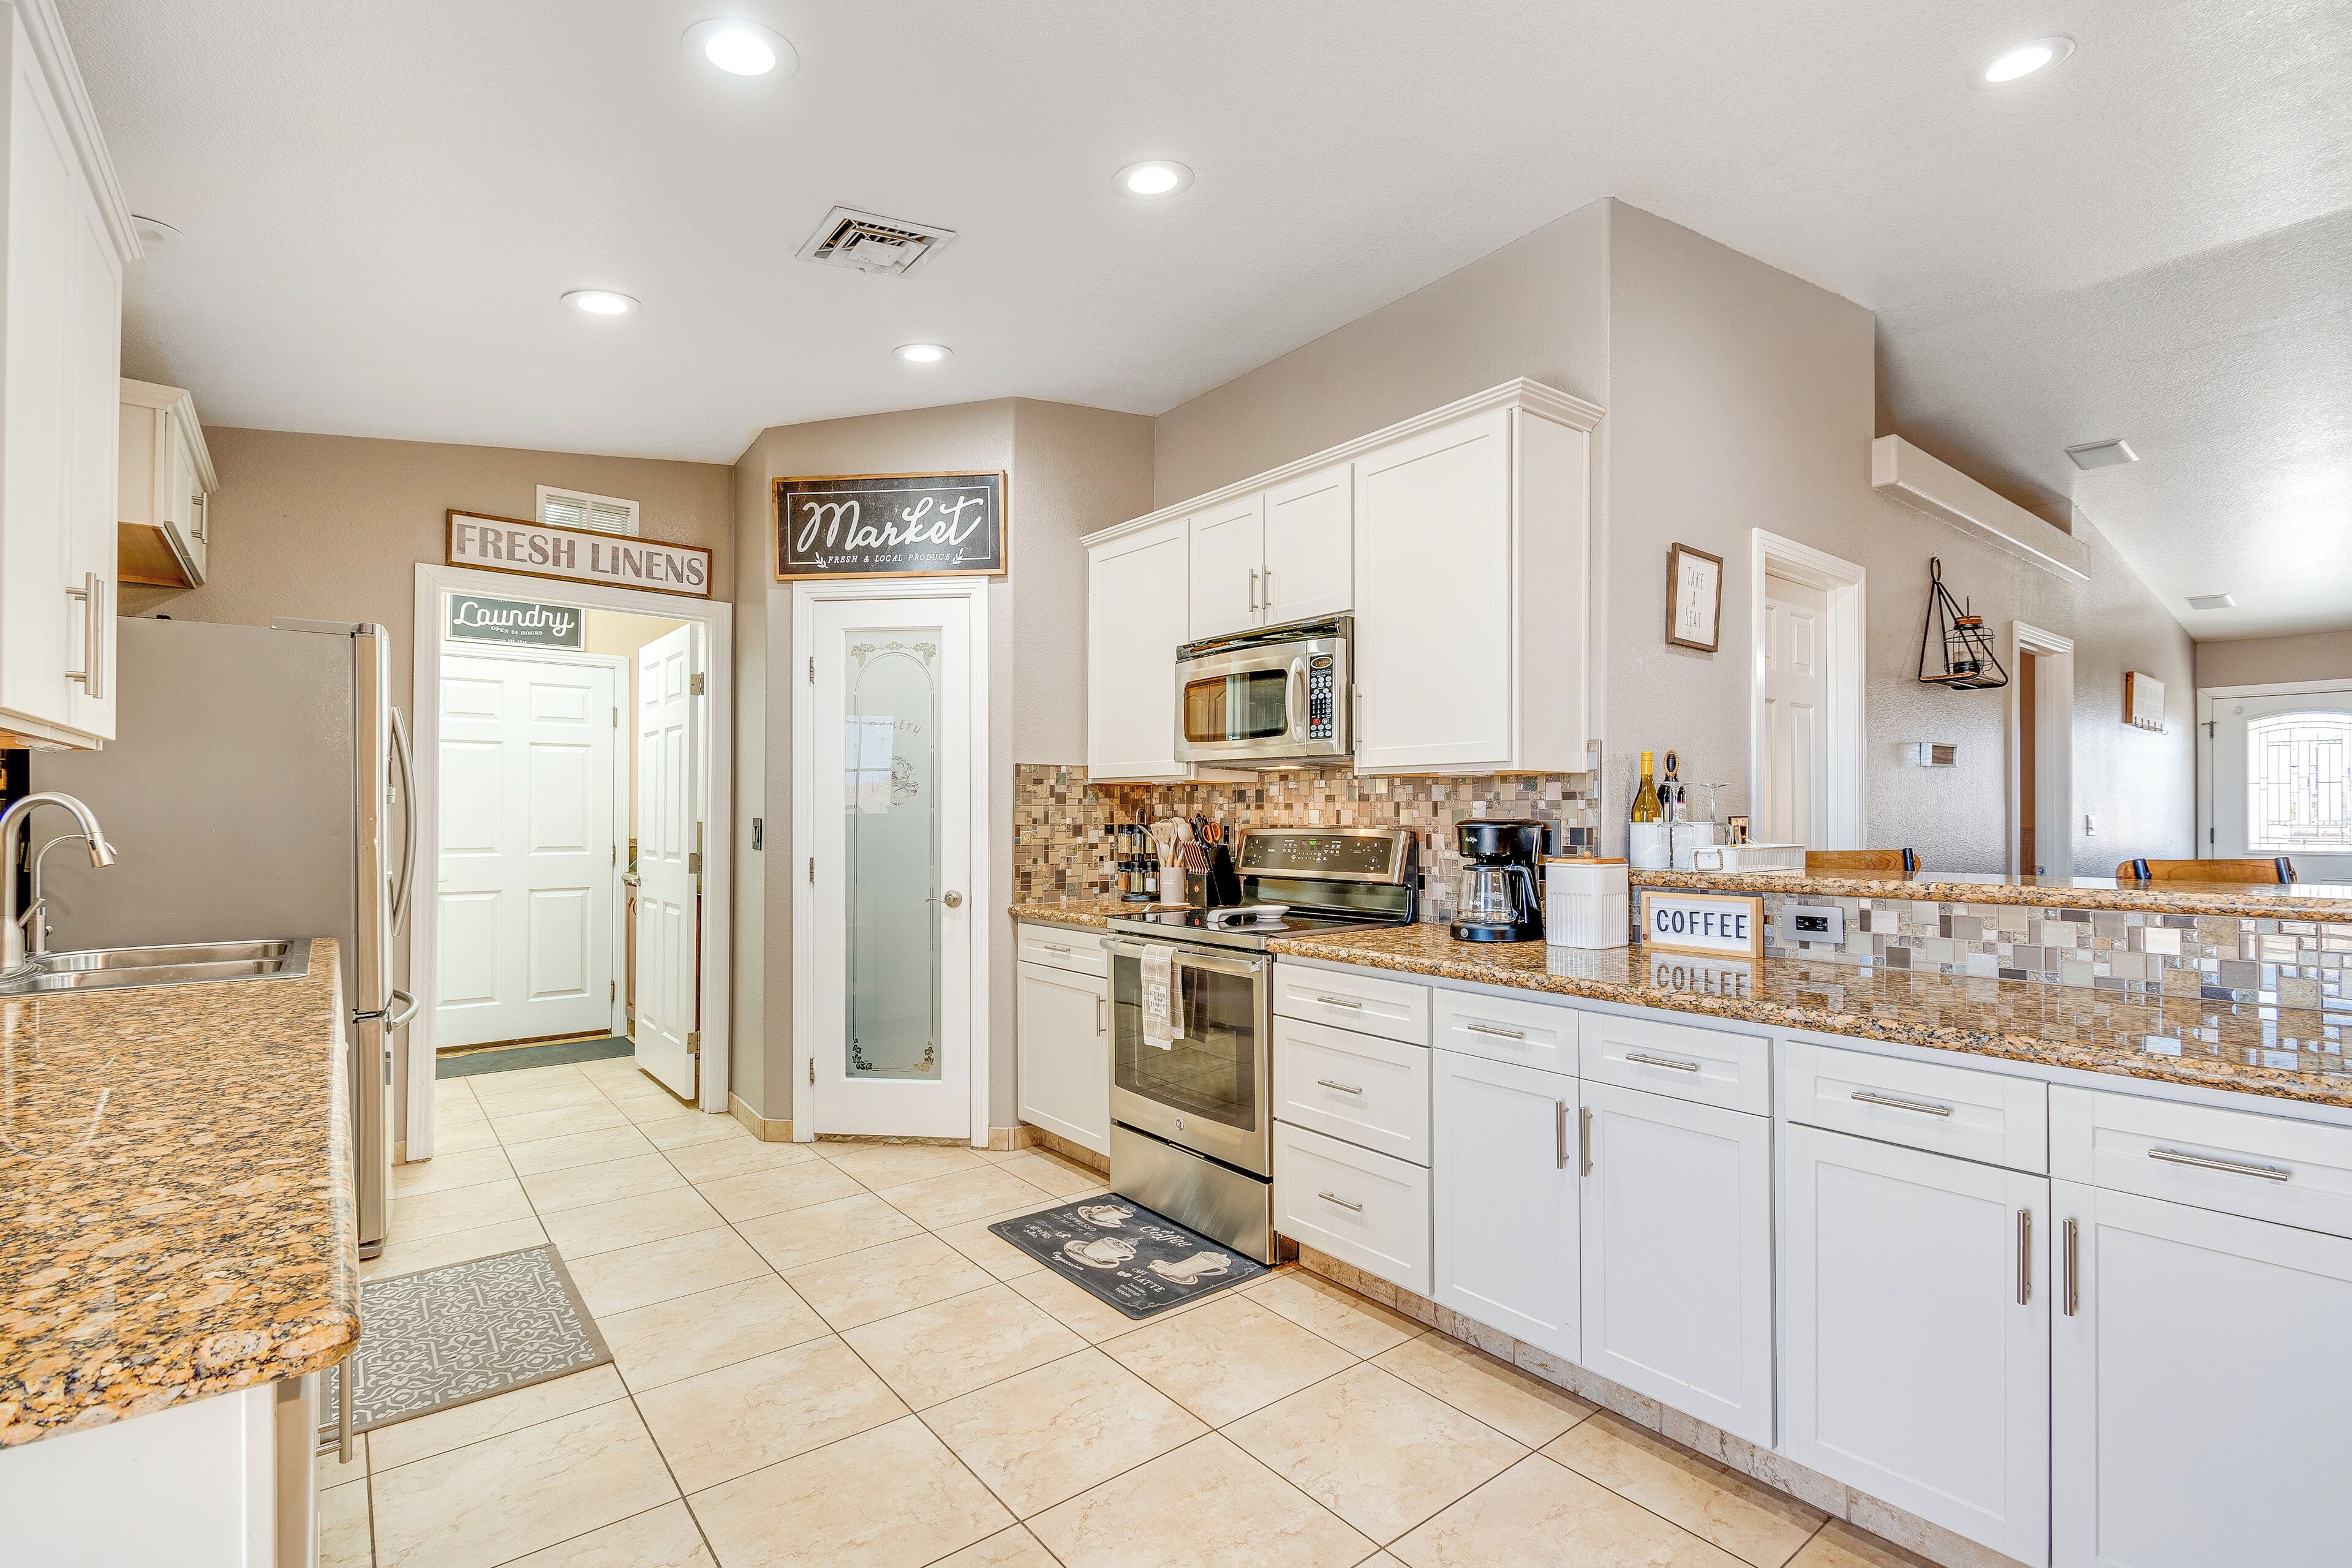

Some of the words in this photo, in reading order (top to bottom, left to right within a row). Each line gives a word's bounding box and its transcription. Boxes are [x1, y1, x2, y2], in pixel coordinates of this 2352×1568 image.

[797, 496, 984, 552] Market
[456, 522, 576, 569] FRESH
[590, 543, 704, 586] LINENS
[827, 554, 858, 564] FRESH
[874, 554, 903, 563] LOCAL
[908, 552, 951, 562] PRODUCE
[1687, 567, 1704, 590] TAKE
[1692, 591, 1695, 608] A
[453, 601, 575, 638] Laundry
[1686, 607, 1701, 629] SEAT
[491, 625, 510, 634] OPEN
[1656, 910, 1747, 939] COFFEE
[1151, 1001, 1166, 1009] HAPPY
[1139, 1226, 1193, 1248] Coffee
[1132, 1275, 1166, 1293] LATTE
